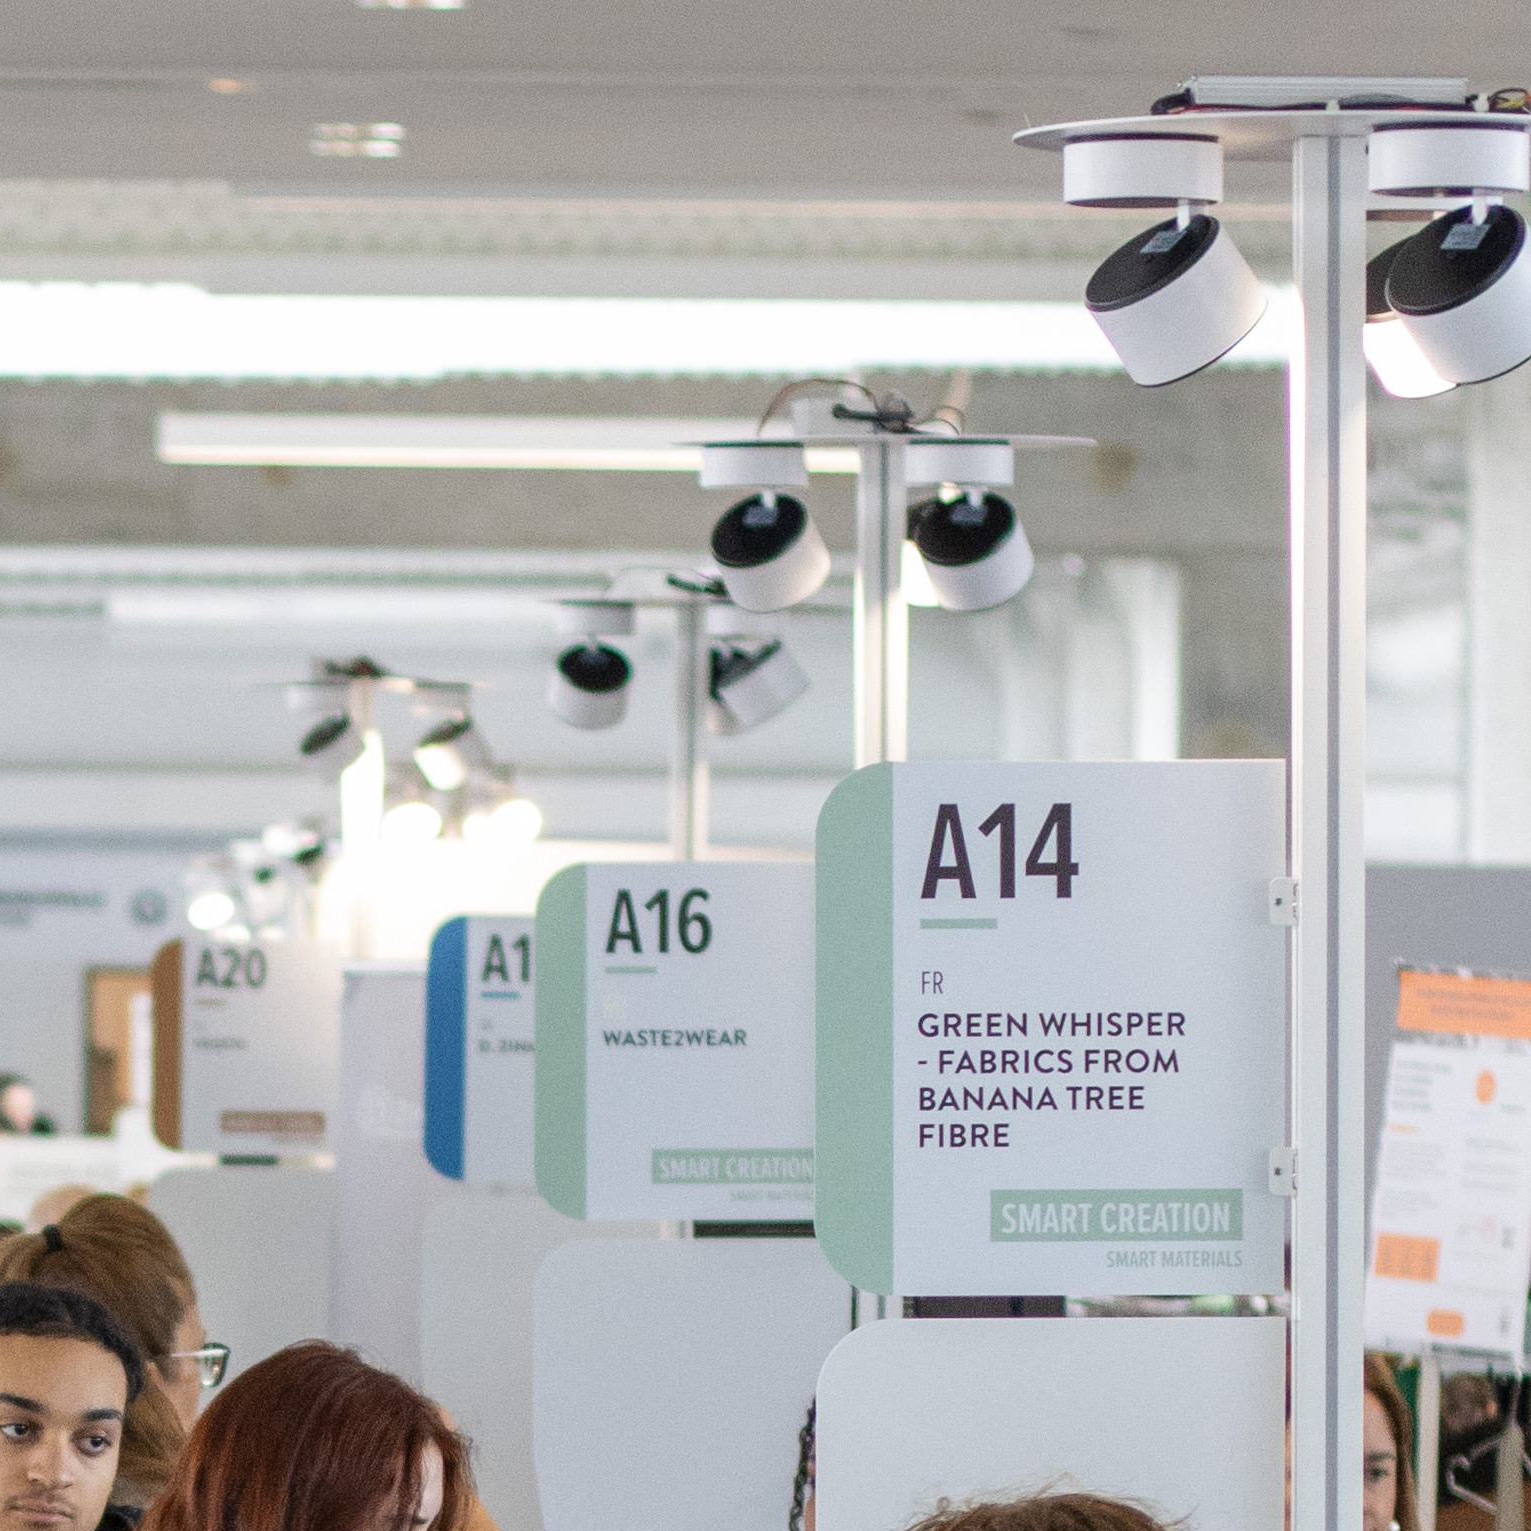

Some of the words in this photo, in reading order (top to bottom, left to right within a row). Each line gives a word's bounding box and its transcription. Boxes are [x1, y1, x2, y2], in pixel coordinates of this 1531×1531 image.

[920, 803, 1079, 900] A14
[606, 889, 712, 953] A16
[196, 948, 266, 988] A20
[481, 933, 531, 984] A1
[921, 971, 944, 996] FR
[603, 1029, 747, 1046] WASTE2WEAR
[918, 1012, 1028, 1038] GREEN
[1039, 1012, 1186, 1038] WHISPER
[938, 1049, 1074, 1075] FABRICS
[1084, 1049, 1180, 1075] FROM
[918, 1086, 1058, 1112] BANANA
[1065, 1086, 1145, 1112] TREE
[918, 1123, 1011, 1149] FIBRE
[659, 1158, 720, 1178] SMART
[726, 1158, 813, 1178] CREATION
[1001, 1202, 1092, 1234] SMART
[1101, 1202, 1230, 1234] CREATION
[1106, 1250, 1157, 1268] SMART
[1161, 1250, 1243, 1268] MATERIALS
